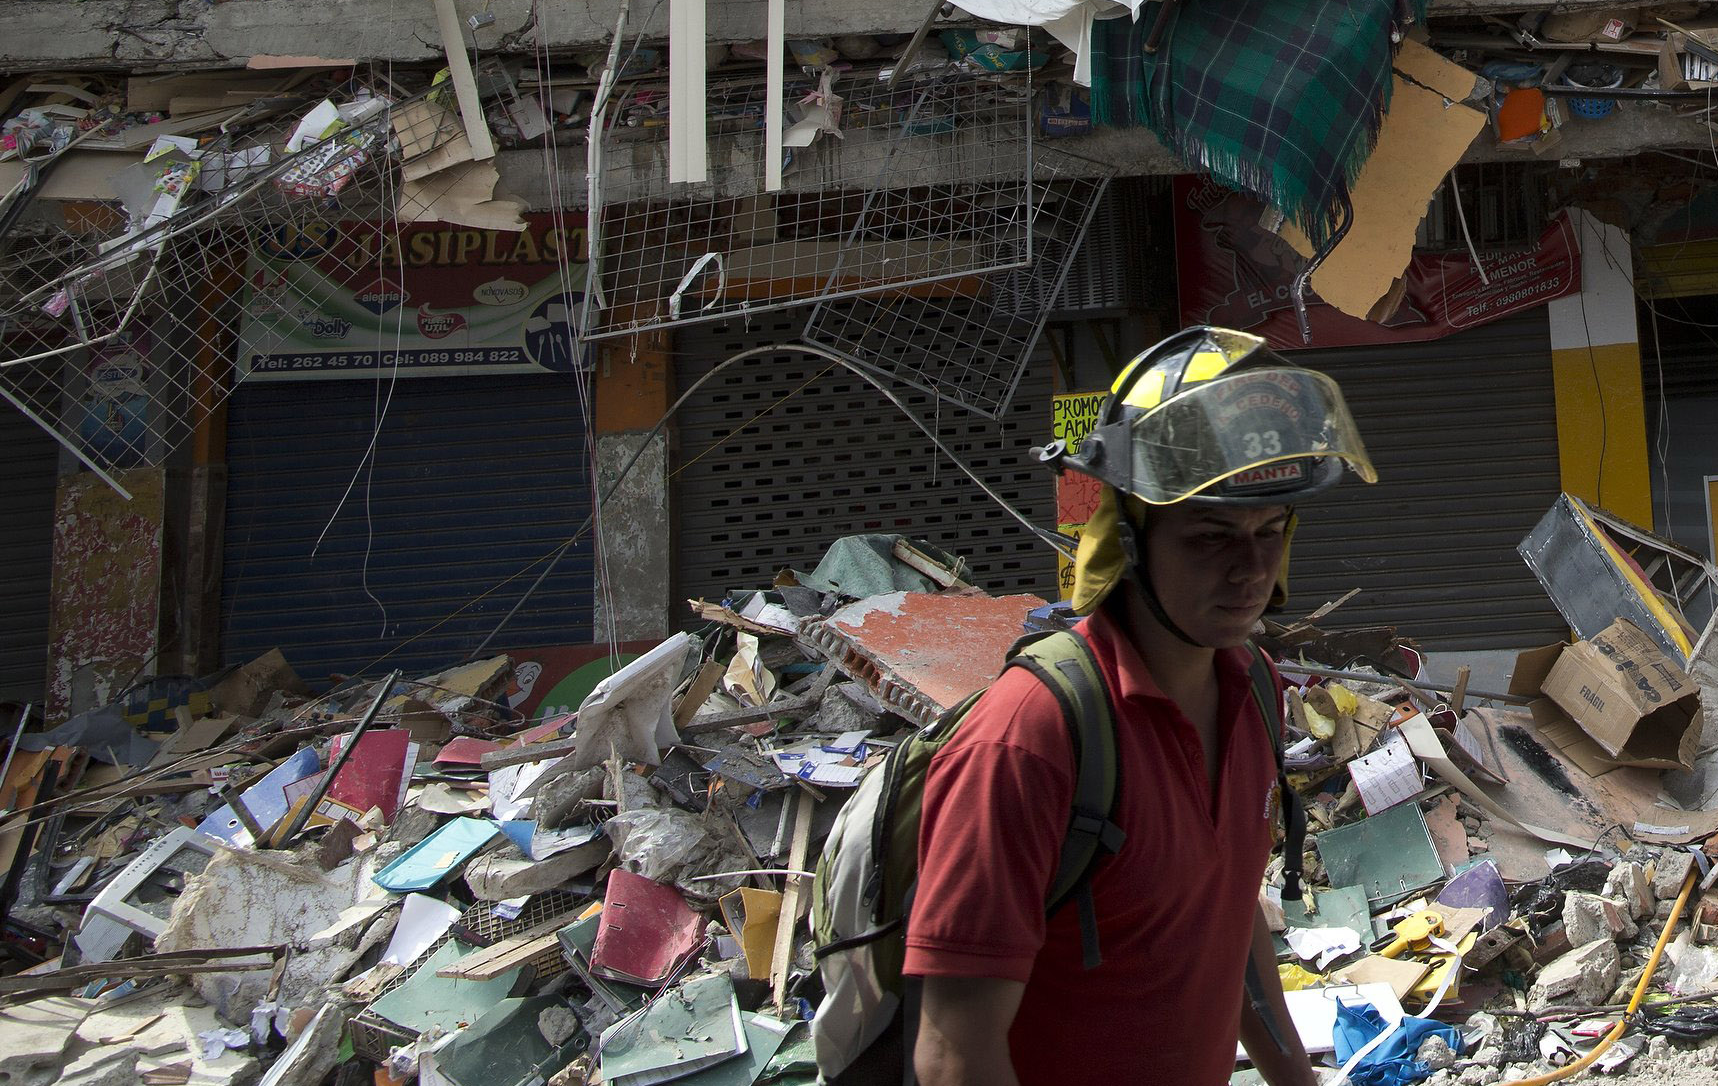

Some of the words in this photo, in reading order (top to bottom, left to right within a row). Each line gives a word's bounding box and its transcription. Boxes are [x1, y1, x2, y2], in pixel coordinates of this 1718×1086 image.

[1490, 257, 1538, 281] MENOR
[1247, 290, 1272, 308] EL
[312, 317, 352, 340] Dolly
[258, 356, 288, 370] Tel:
[291, 355, 323, 369] 262
[327, 354, 349, 368] 45
[352, 353, 374, 367] 70
[382, 352, 414, 366] Cel:
[419, 351, 451, 365] 089
[454, 350, 486, 364] 984
[489, 349, 520, 363] 822
[1243, 430, 1283, 459] 33
[1233, 464, 1300, 485] MANTA
[1579, 684, 1606, 714] FRAGIL
